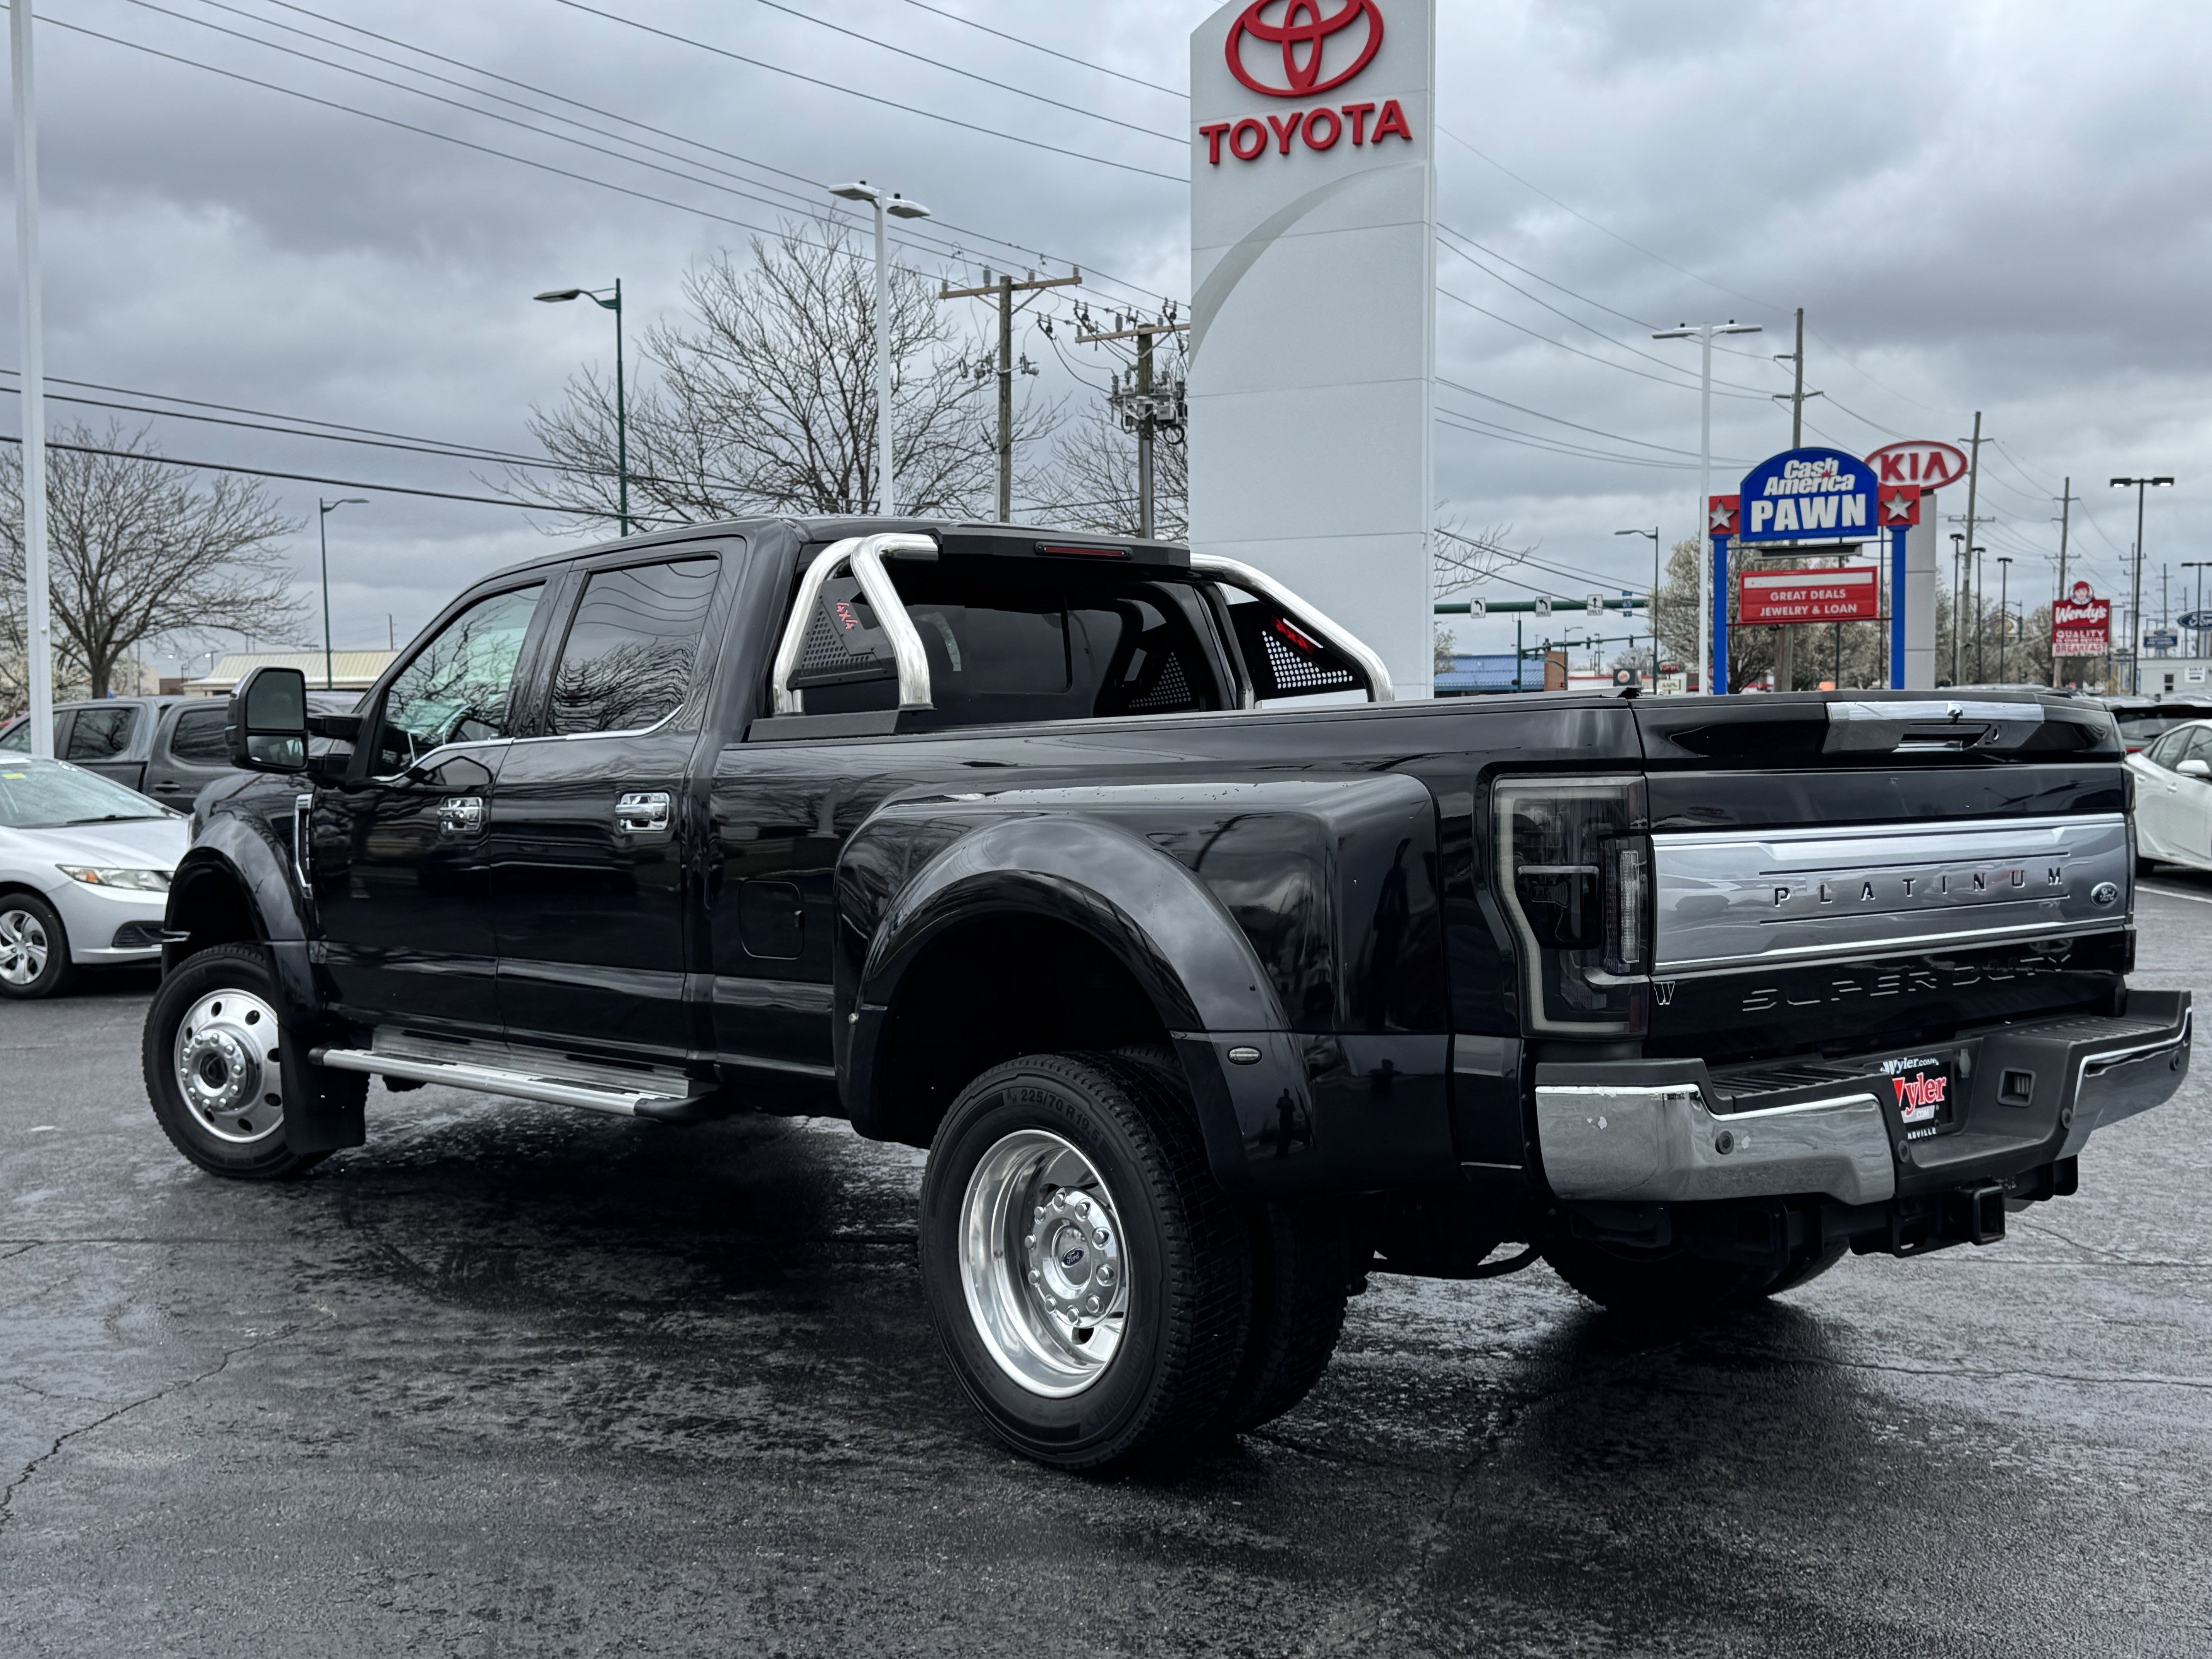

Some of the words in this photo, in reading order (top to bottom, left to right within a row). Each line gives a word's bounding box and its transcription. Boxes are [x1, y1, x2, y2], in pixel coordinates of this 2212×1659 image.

[1199, 99, 1413, 165] TOYOTA
[1784, 457, 1839, 479] Cash
[1880, 452, 1949, 481] KIA
[1763, 474, 1855, 496] America
[1751, 494, 1866, 532] PAWN
[1770, 590, 1807, 601] GREAT
[1810, 589, 1846, 599] DEALS
[1760, 605, 1808, 617] JEWELRY
[1812, 604, 1820, 613] &
[1824, 604, 1857, 614] LOAN
[2055, 603, 2107, 624] Wendy's
[2056, 630, 2105, 639] QUALITY
[1774, 867, 2062, 907] PLATINUM
[1742, 971, 1937, 1012] SUPER
[1952, 953, 2071, 986] DUTY
[1021, 1089, 1063, 1111] 225/70
[1066, 1104, 1075, 1120] R
[1077, 1113, 1101, 1142] 19.5
[1066, 1251, 1080, 1264] Ford
